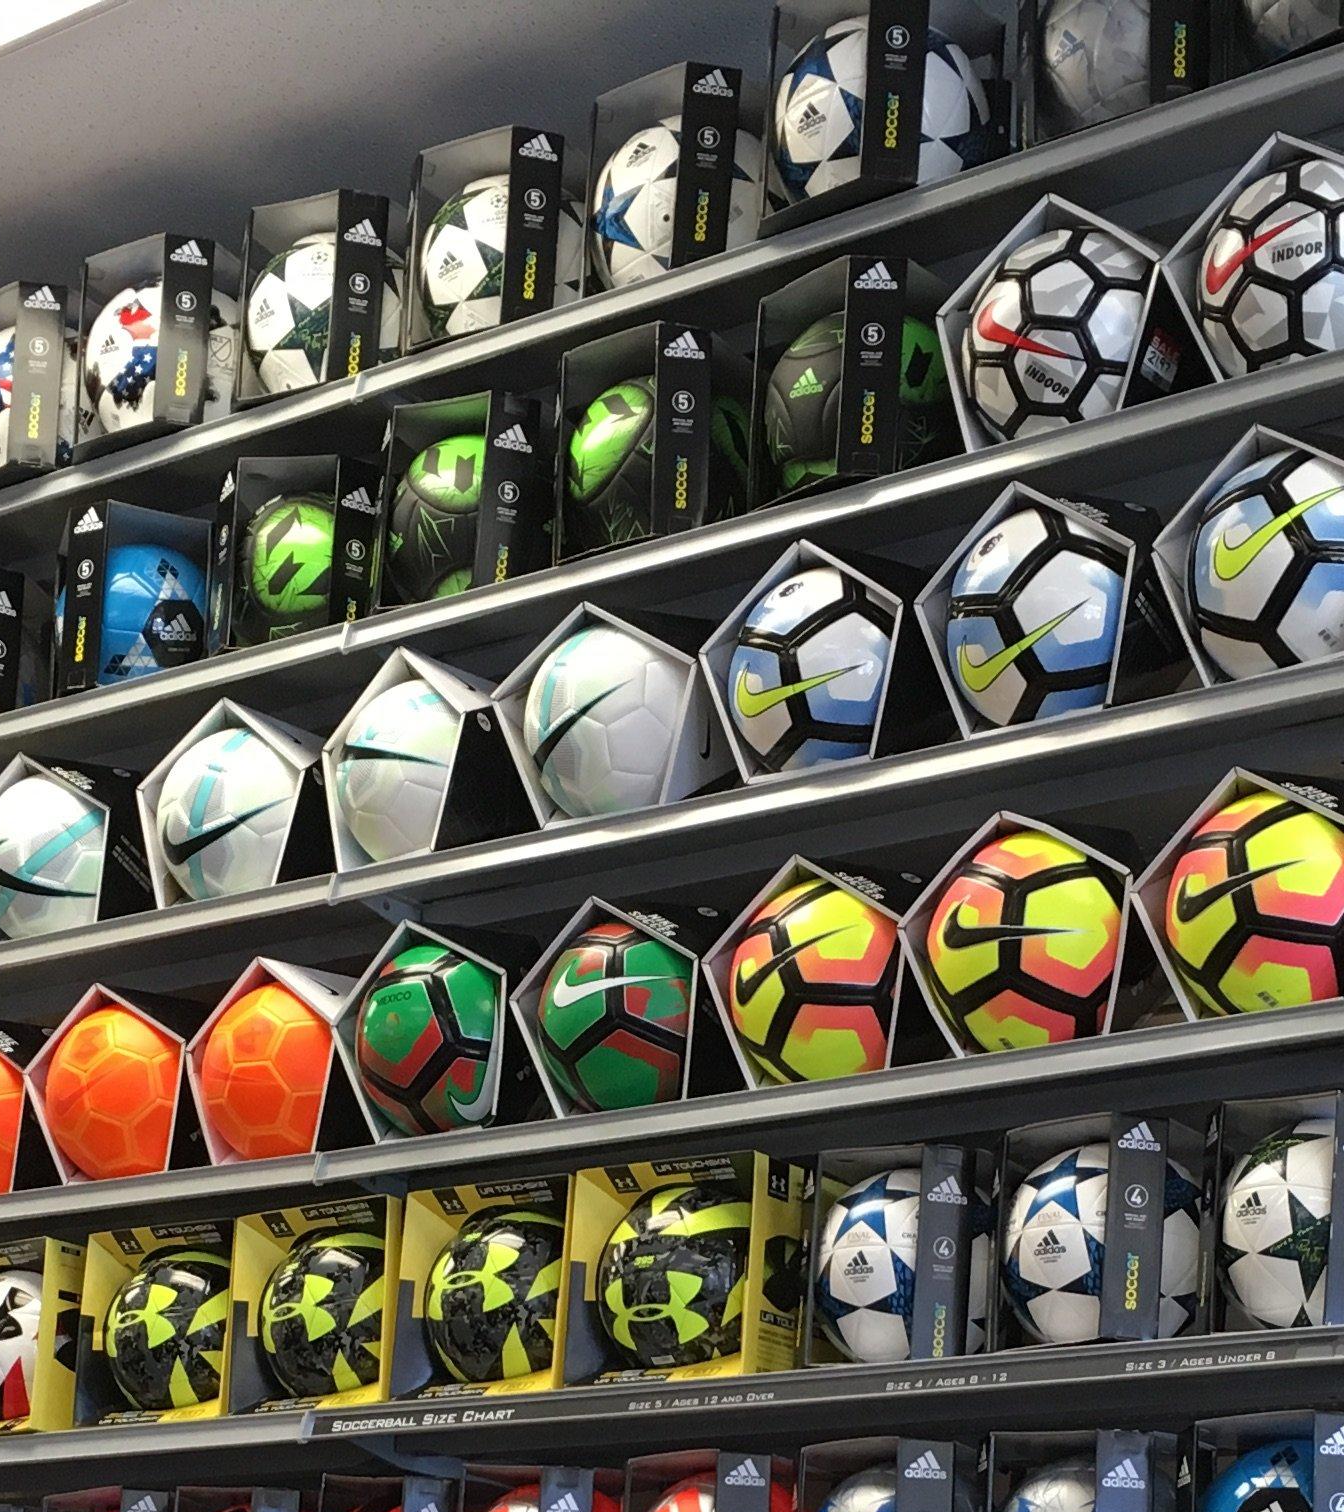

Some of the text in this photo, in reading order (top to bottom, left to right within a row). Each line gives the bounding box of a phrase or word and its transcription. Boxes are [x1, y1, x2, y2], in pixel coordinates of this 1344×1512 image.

[1174, 20, 1187, 78] soccer
[692, 84, 733, 97] adidas
[1271, 240, 1323, 264] INDOOR
[24, 300, 61, 311] adidas
[175, 349, 188, 397] soccer
[1025, 364, 1069, 398] INDOOR
[861, 390, 875, 444] soccer
[341, 499, 376, 515] adidas
[1117, 1139, 1161, 1151] adidas
[927, 1192, 968, 1205] adidas
[904, 1467, 947, 1480] adidas
